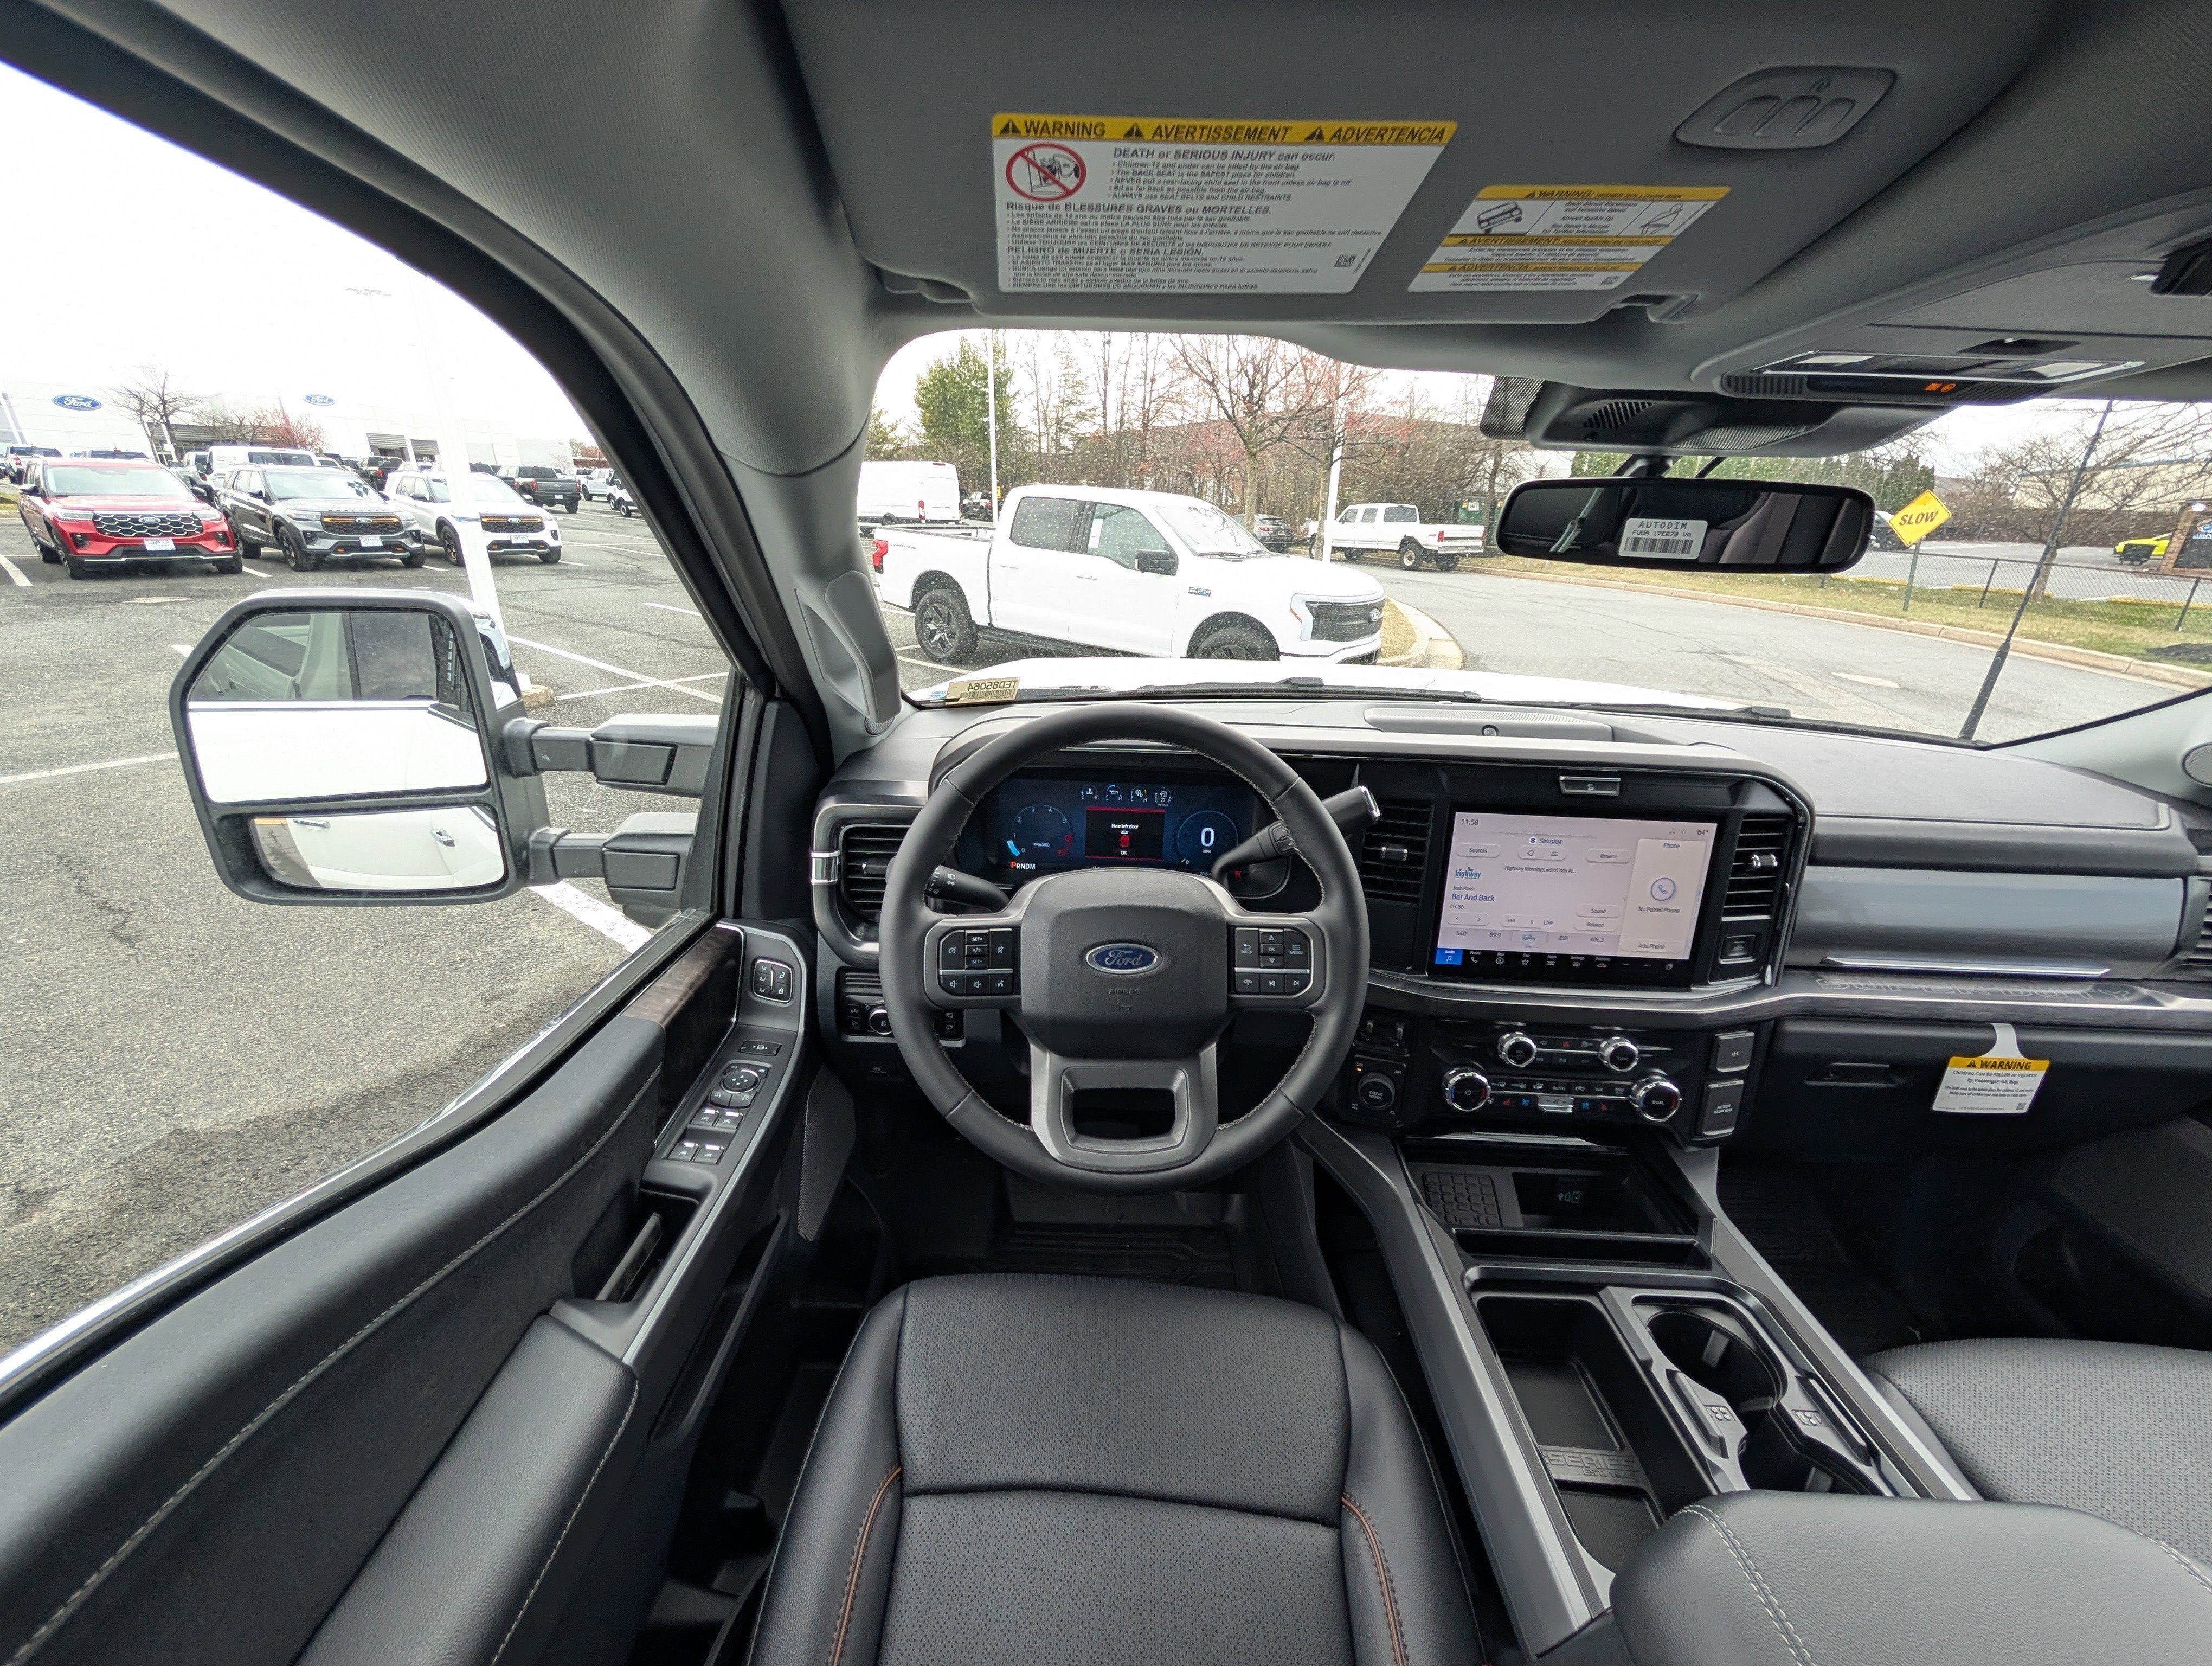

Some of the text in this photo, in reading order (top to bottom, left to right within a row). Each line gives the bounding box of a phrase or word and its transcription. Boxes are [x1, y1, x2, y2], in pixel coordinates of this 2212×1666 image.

[1024, 120, 1447, 143] WARNING AVERTISSEMENT ADVERTENCIA
[1114, 146, 1155, 159] DEATH
[1173, 149, 1229, 161] SERIOUS
[1231, 149, 1276, 162] INJURY
[1278, 152, 1297, 161] can
[1302, 152, 1335, 162] occur.
[1007, 202, 1044, 212] Risque
[1048, 202, 1061, 212] de
[1065, 202, 1133, 213] BLESSURES
[1137, 204, 1182, 214] GRAVES
[1007, 246, 1054, 254] PELIGRO
[1058, 246, 1070, 254] de
[1073, 246, 1117, 255] MUERTE
[1129, 248, 1160, 256] SERIA
[64, 396, 92, 407] Ford
[311, 395, 329, 403] Ford
[1899, 511, 1939, 526] SLOW
[1638, 521, 1688, 530] AUTODIM
[1201, 827, 1214, 847] 0
[1011, 861, 1036, 869] PRNDM
[1455, 869, 1482, 879] highway
[1105, 950, 1143, 966] Ford
[1980, 1060, 2032, 1070] WARNING
